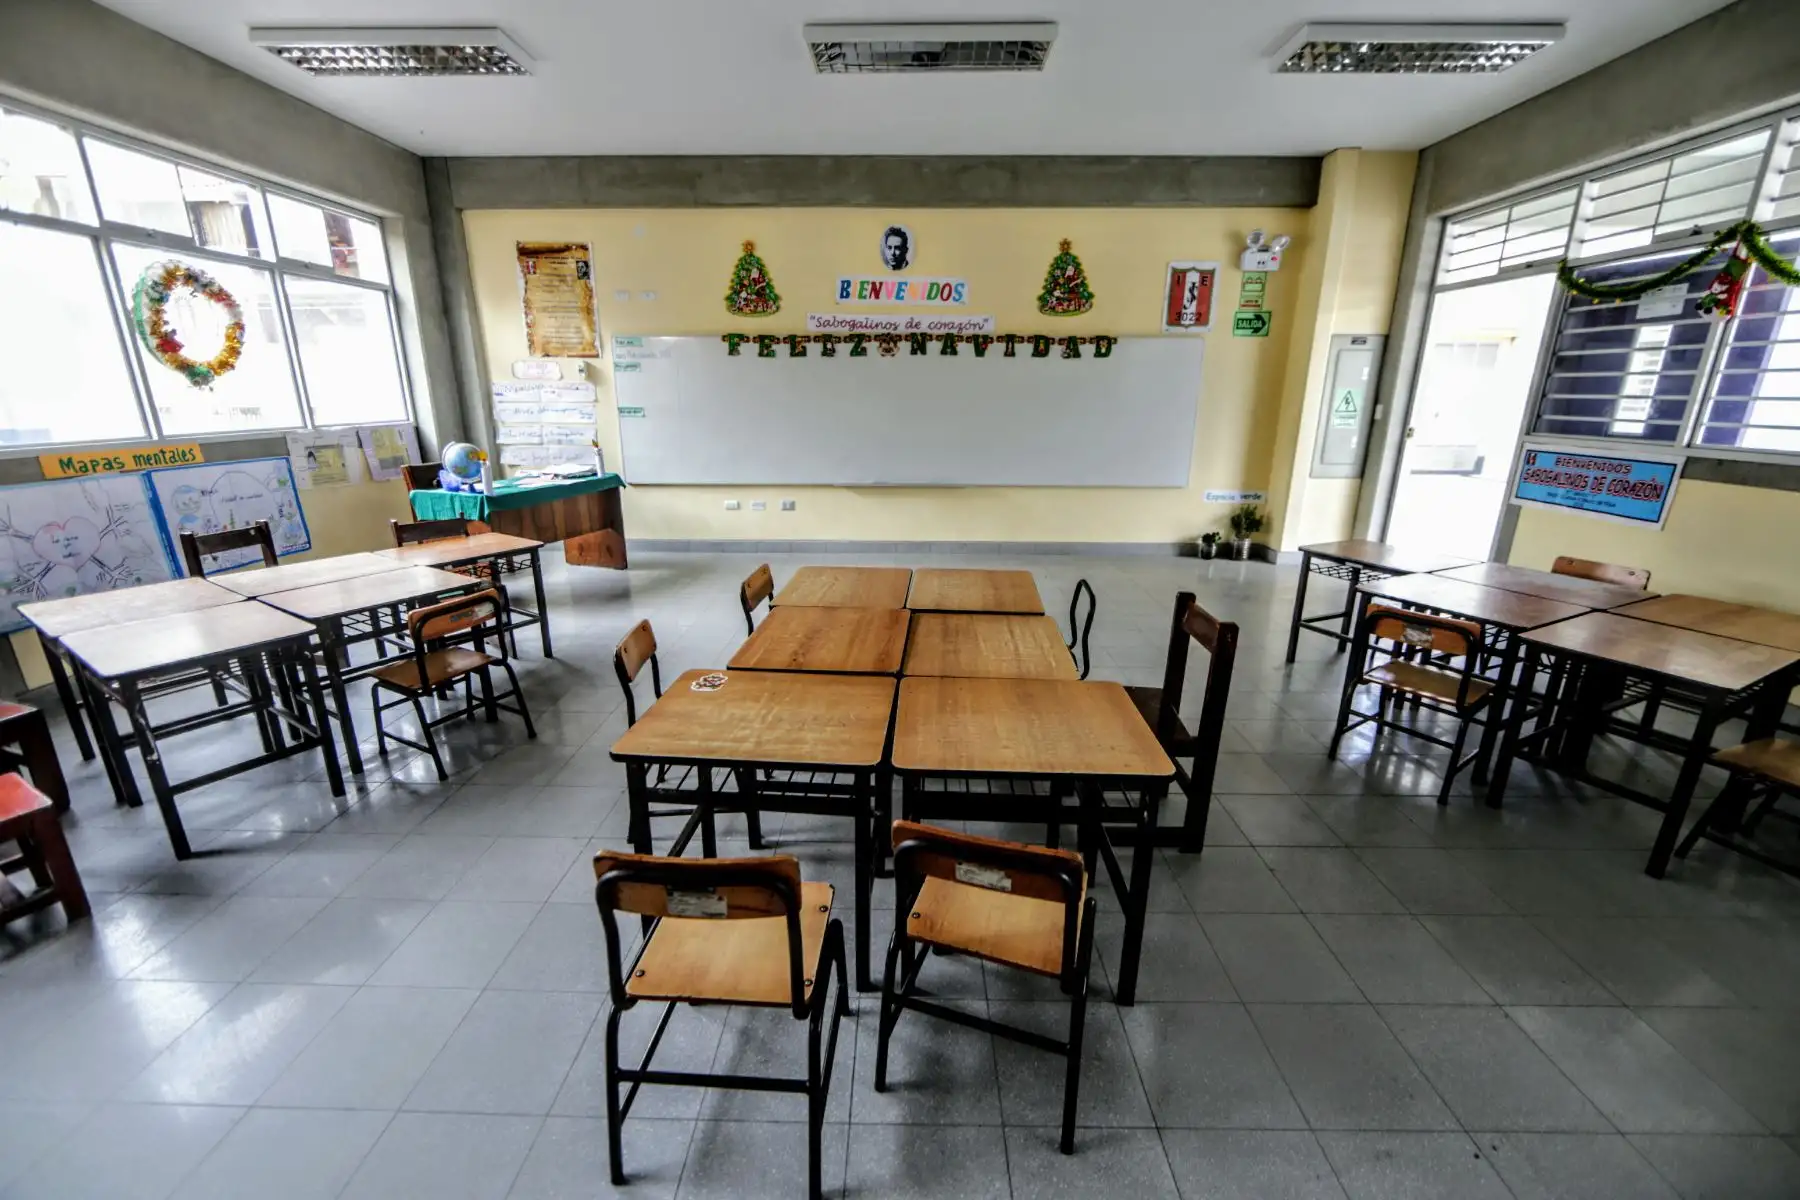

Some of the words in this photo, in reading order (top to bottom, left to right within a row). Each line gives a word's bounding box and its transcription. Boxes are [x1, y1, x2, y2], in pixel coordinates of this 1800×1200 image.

[839, 279, 966, 302] BIENVENIDOS
[1200, 275, 1209, 287] E
[904, 317, 922, 331] de
[1175, 311, 1202, 322] 3022
[1237, 319, 1263, 328] SALIDA
[727, 333, 868, 358] FELIZ
[908, 332, 1114, 358] NAVIDAD
[58, 455, 125, 475] Mapas
[132, 447, 197, 468] mentales
[1555, 456, 1633, 475] BIENVENIDOS
[1590, 476, 1605, 494] DE
[1606, 477, 1665, 502] CORAZÓN
